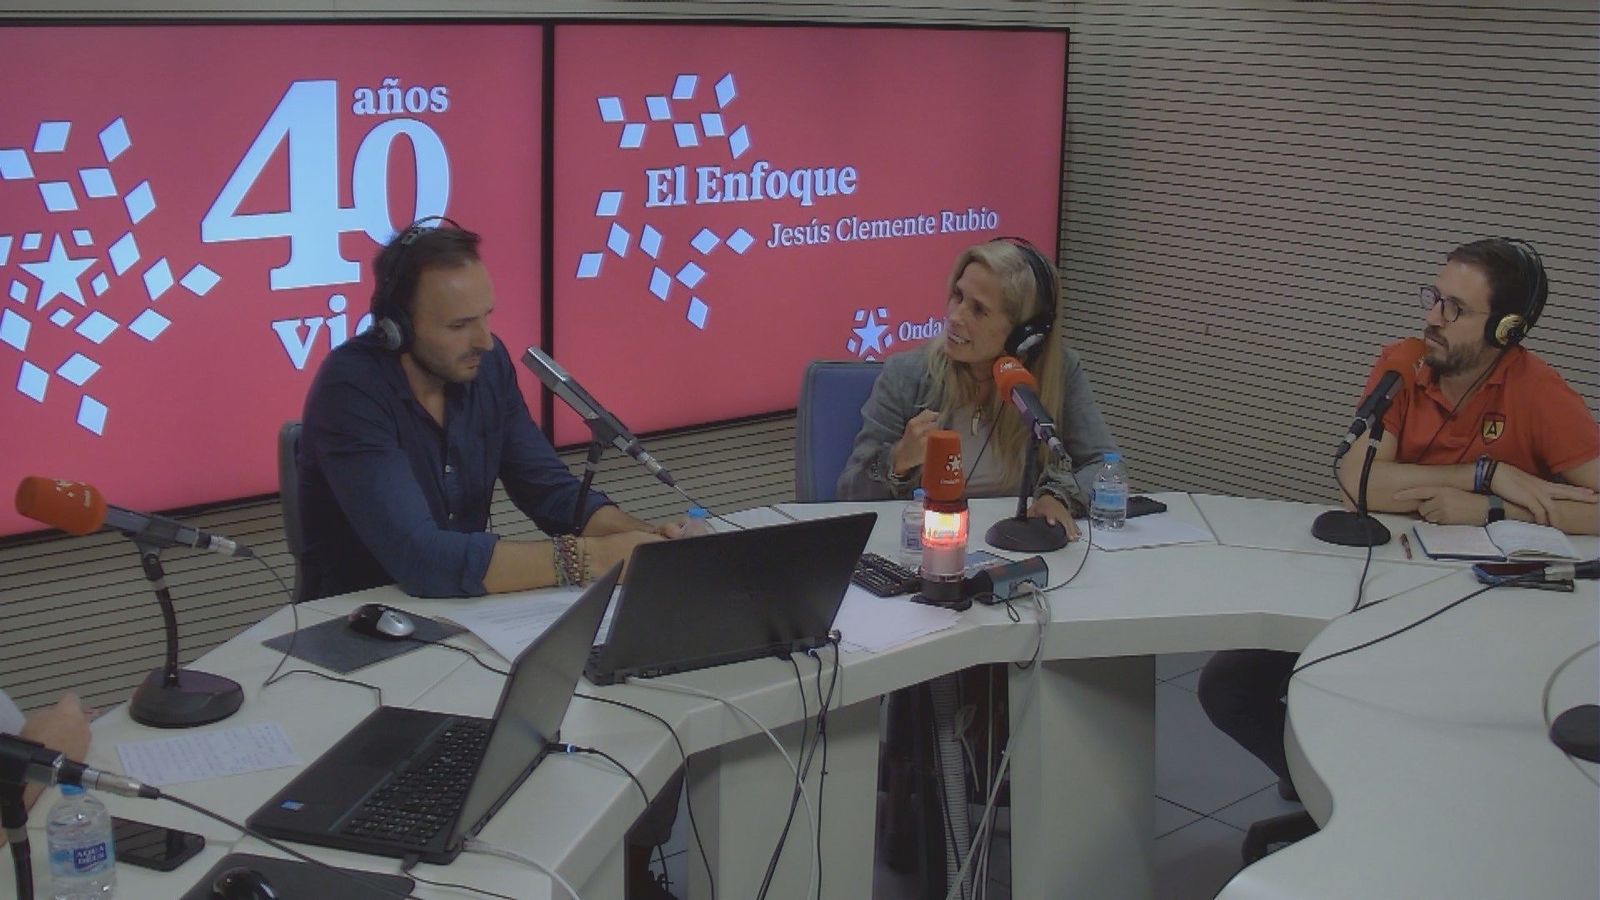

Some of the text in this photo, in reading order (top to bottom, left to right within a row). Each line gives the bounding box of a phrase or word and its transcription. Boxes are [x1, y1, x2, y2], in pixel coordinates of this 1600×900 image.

[352, 77, 449, 115] años
[201, 79, 450, 290] 40
[645, 161, 857, 208] El Enfoque
[767, 207, 998, 248] Jesús Clemente Rubio
[271, 294, 374, 370] vi
[898, 316, 948, 341] Onda
